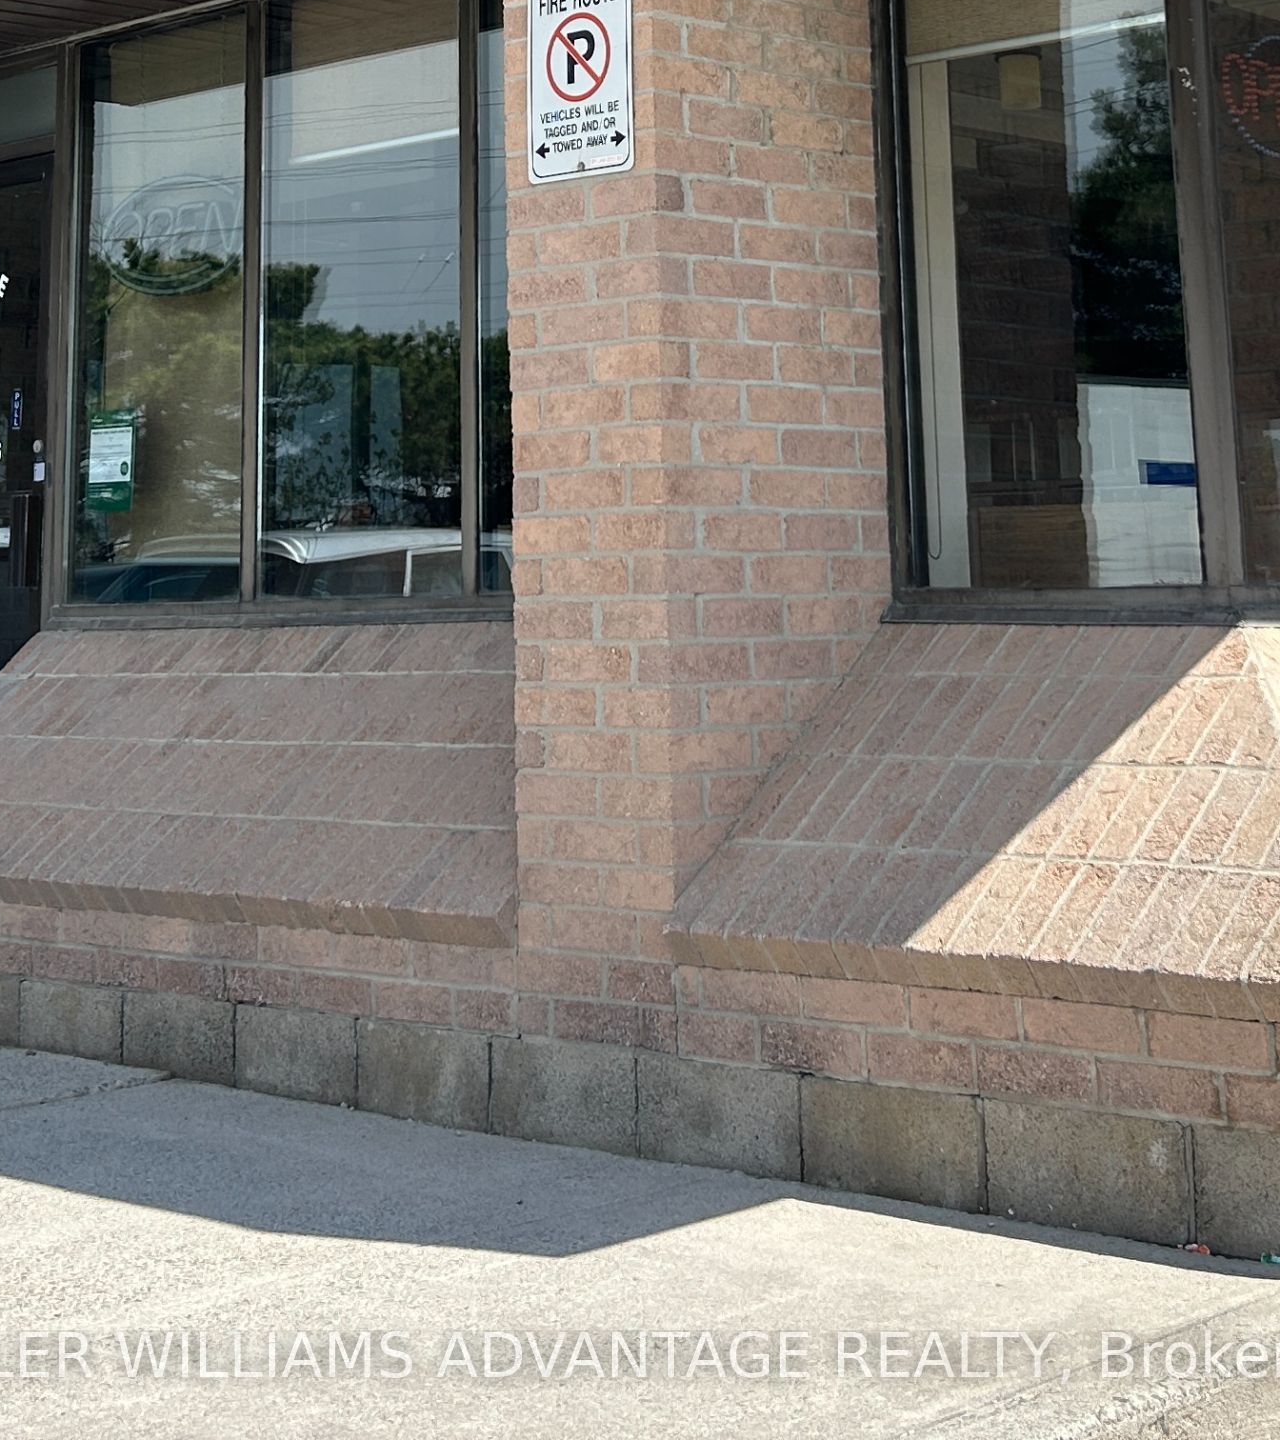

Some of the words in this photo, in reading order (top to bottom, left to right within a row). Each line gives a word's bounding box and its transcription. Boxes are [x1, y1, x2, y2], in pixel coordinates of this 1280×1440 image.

[540, 106, 581, 125] VEHICLES
[585, 102, 604, 117] WILL
[608, 100, 620, 112] BE
[544, 120, 578, 139] TAGGED
[581, 116, 617, 133] AND/OR
[552, 136, 583, 154] TOWED
[586, 134, 608, 148] AWAY
[13, 391, 21, 427] PULL
